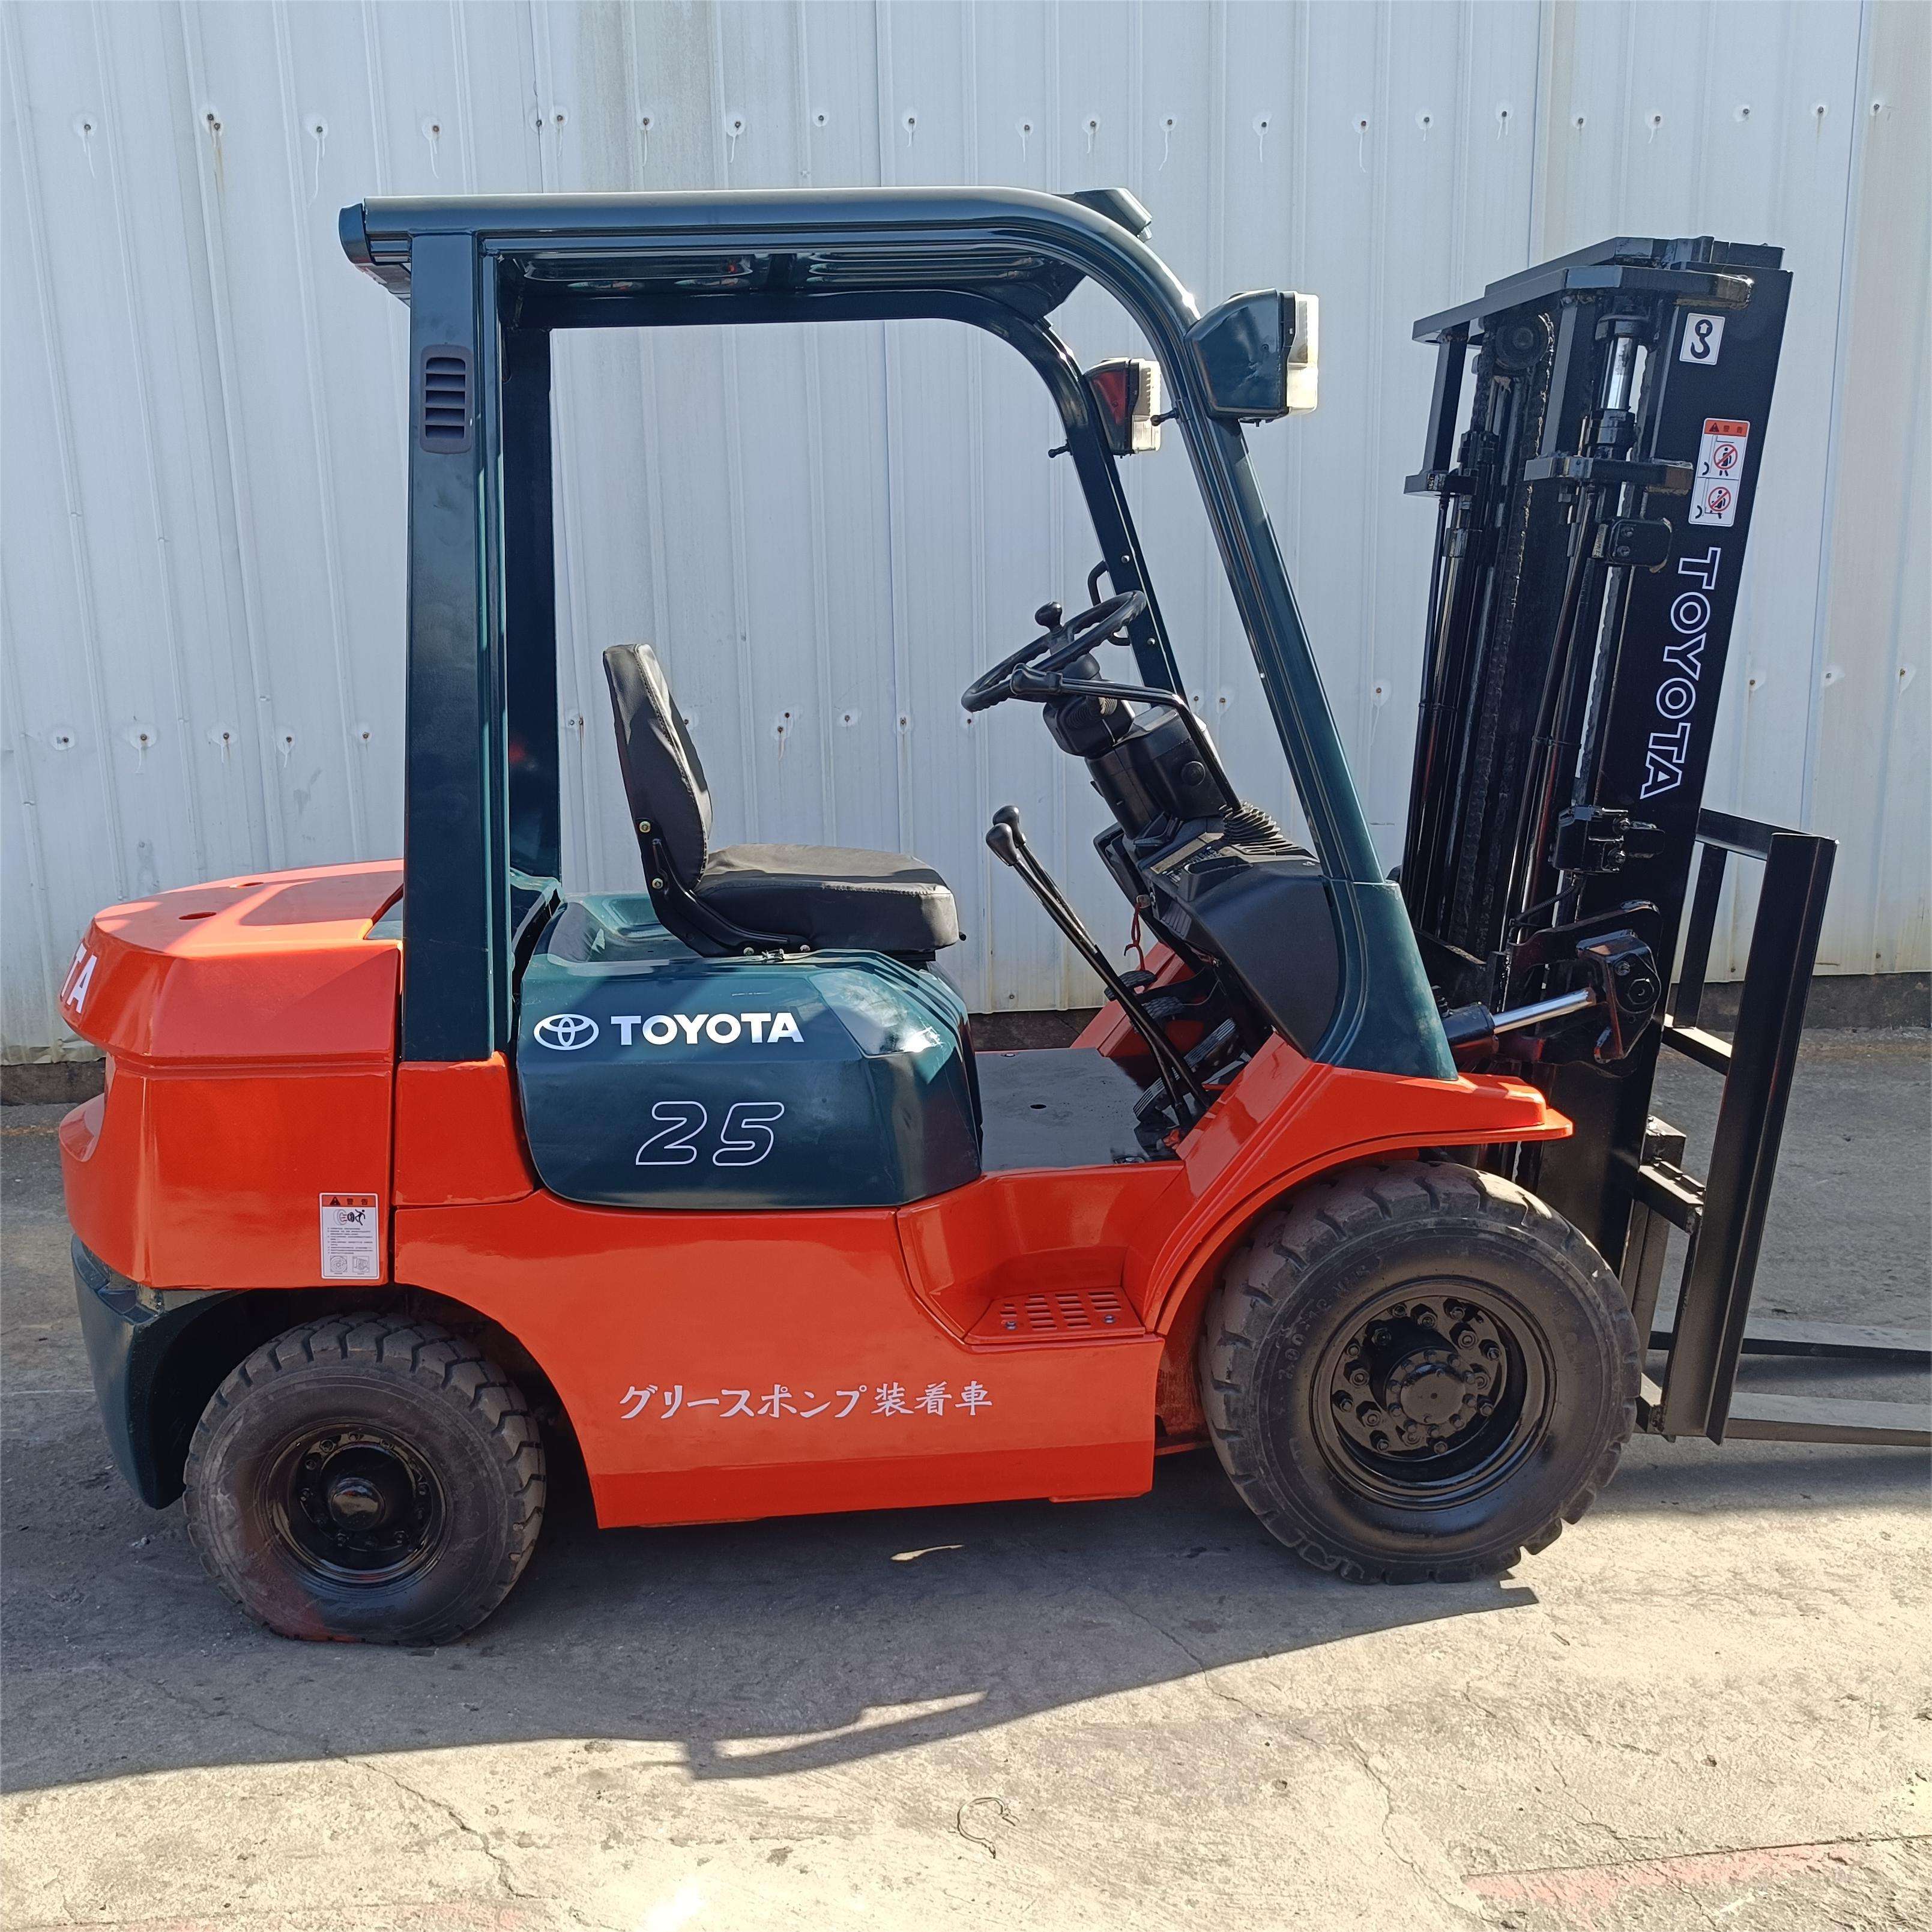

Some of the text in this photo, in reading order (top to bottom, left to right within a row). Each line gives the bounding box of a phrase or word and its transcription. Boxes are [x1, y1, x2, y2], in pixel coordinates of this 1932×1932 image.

[1640, 546, 1721, 800] TOYOTA
[610, 1012, 804, 1045] TOYOTA
[635, 1100, 785, 1167] 25
[619, 1380, 993, 1419] グリースポンプ装着車
